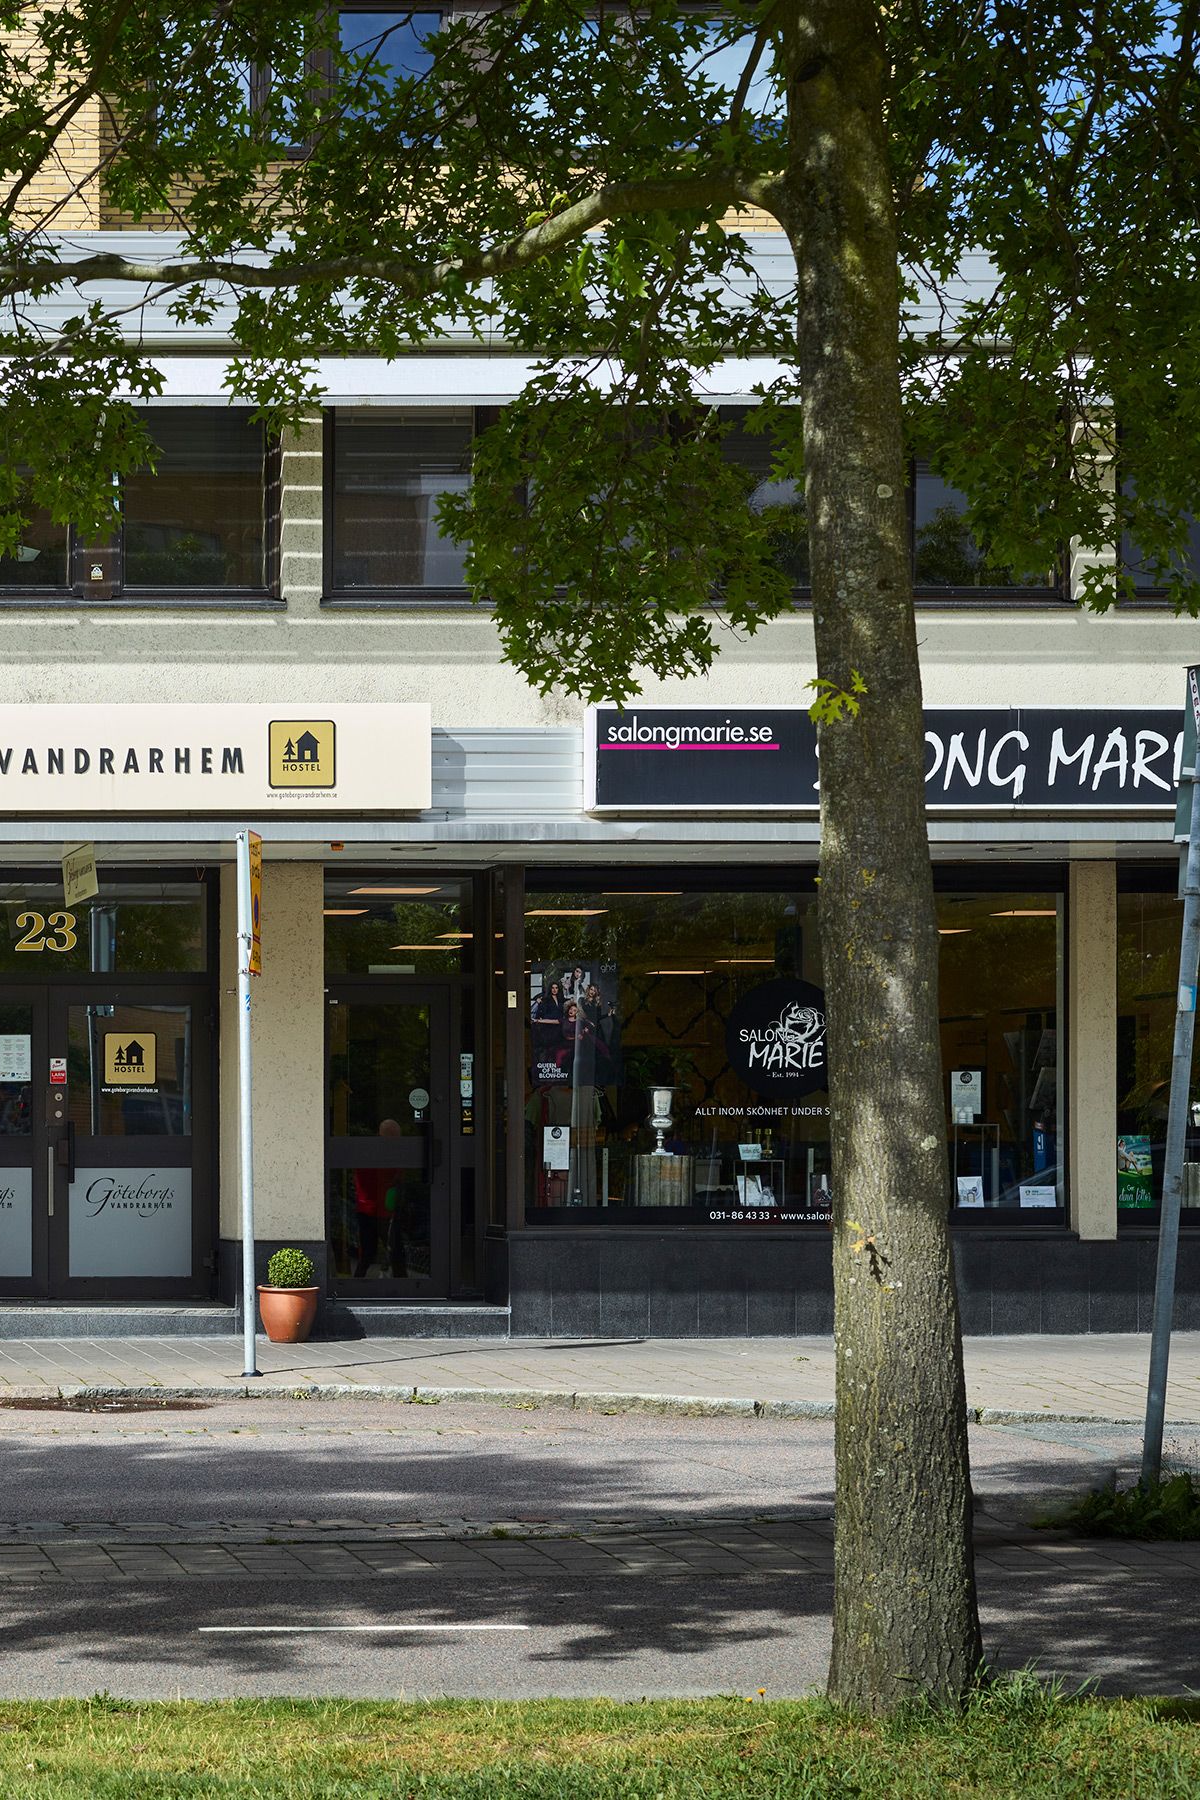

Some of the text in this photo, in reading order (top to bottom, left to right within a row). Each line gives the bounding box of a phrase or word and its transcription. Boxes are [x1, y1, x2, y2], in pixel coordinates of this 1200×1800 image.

[607, 715, 773, 749] salongmarie.se
[282, 763, 321, 772] HOSTEL
[14, 911, 78, 951] 23
[695, 1107, 716, 1116] ALLT
[718, 1107, 743, 1116] INOM
[746, 1105, 789, 1116] SKÖNHET
[791, 1107, 822, 1116] UNDER
[85, 1173, 175, 1218] Göteborgs
[745, 1211, 757, 1220] 43
[759, 1211, 770, 1220] 33
